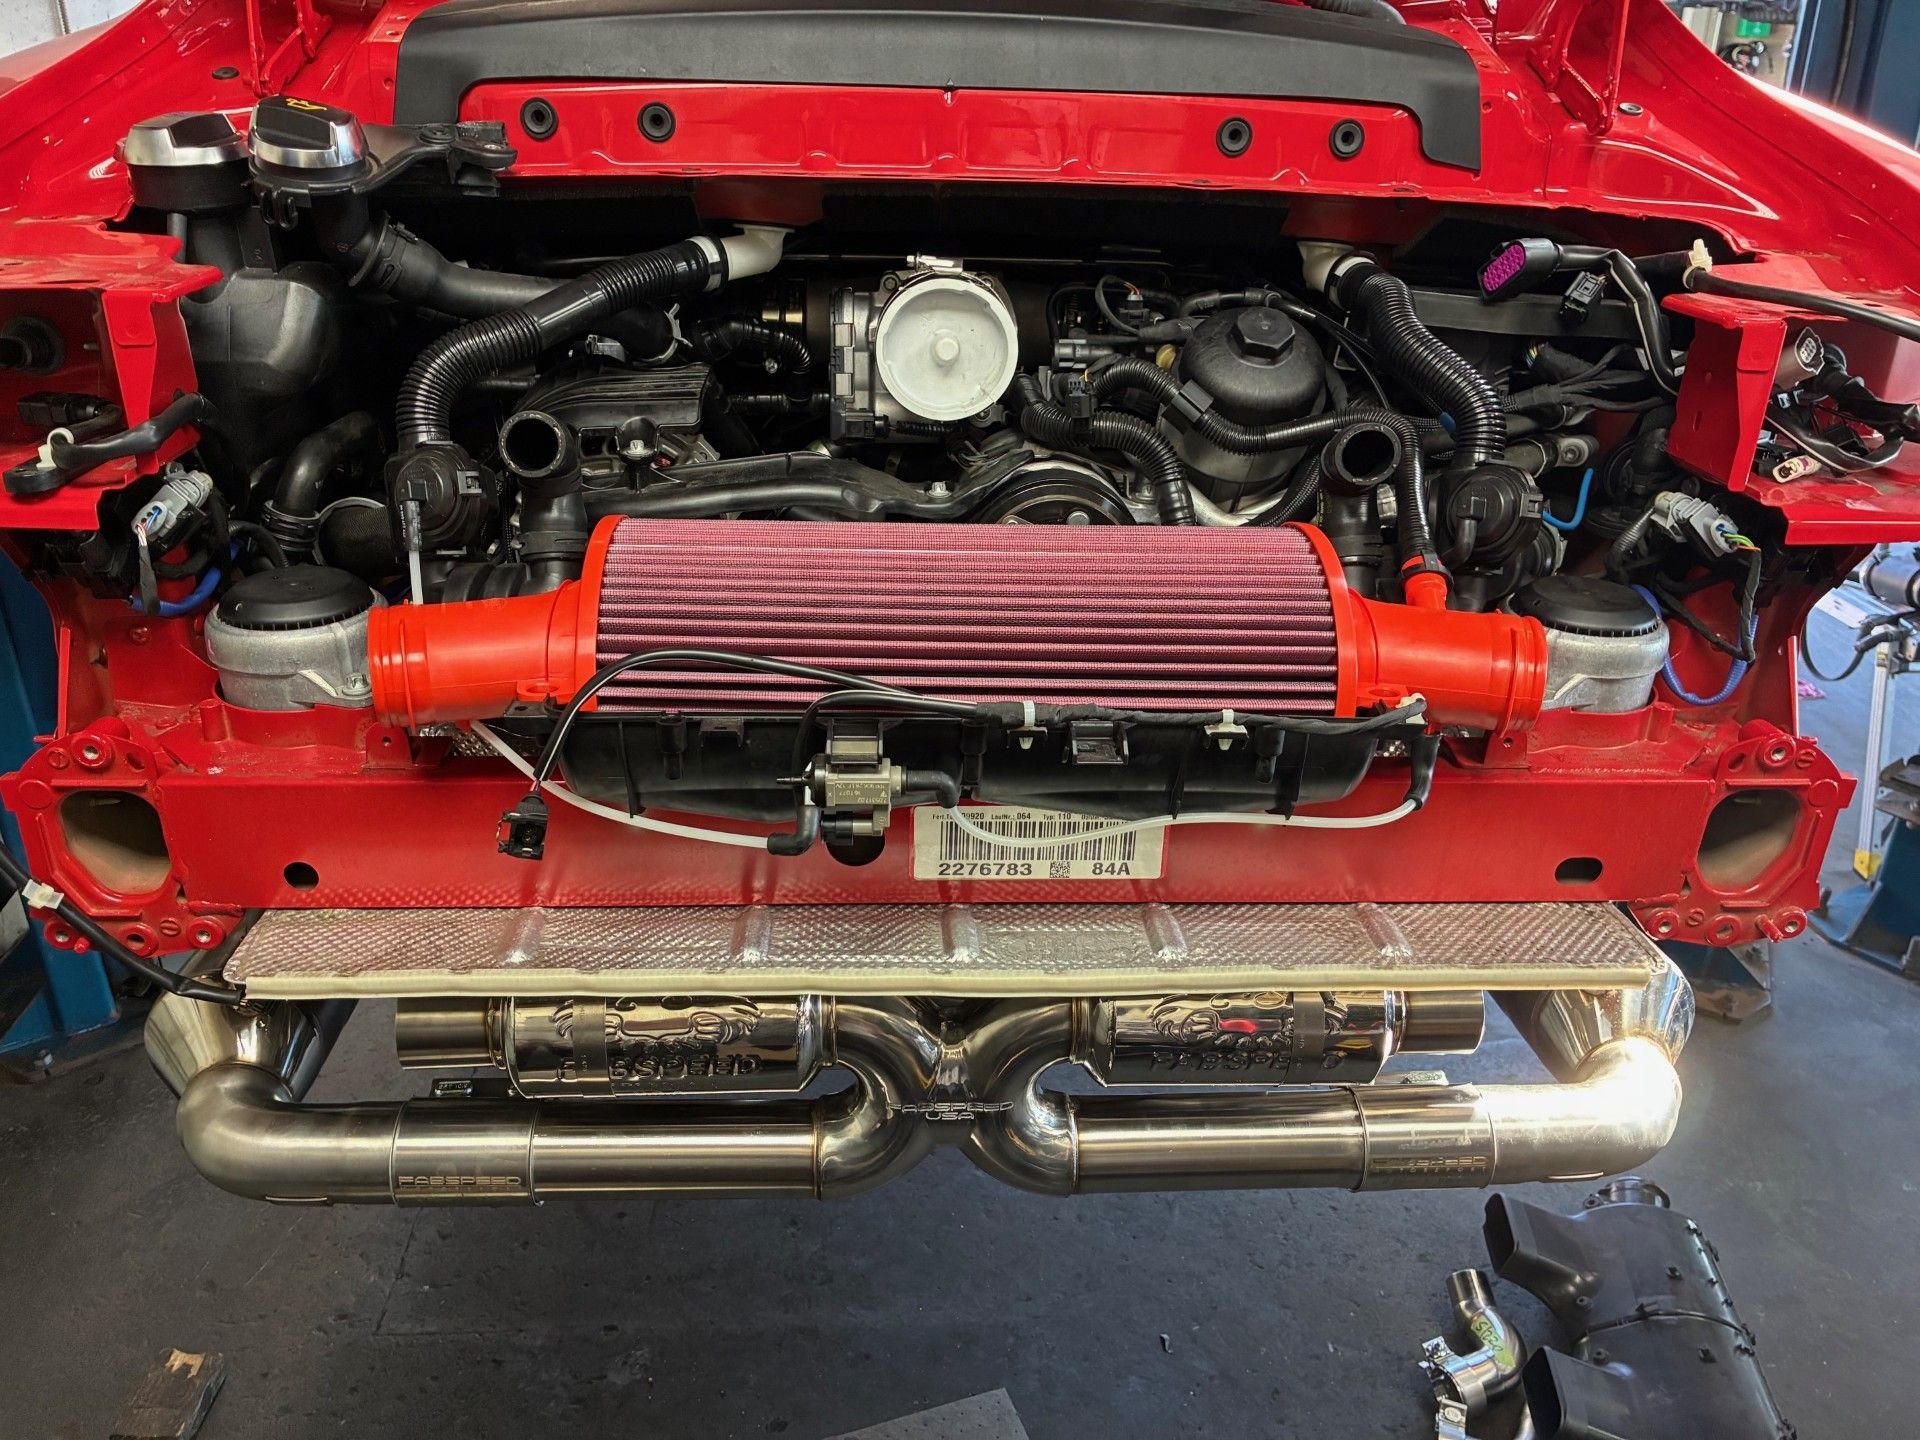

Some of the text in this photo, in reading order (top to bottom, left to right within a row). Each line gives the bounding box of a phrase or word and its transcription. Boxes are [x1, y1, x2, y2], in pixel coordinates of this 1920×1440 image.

[1016, 812, 1031, 820] 064
[1058, 812, 1072, 820] 110
[938, 862, 1131, 876] 2276783 84A
[1150, 1050, 1346, 1071] FABSPED
[556, 1053, 763, 1084] FBSPEED
[925, 1111, 975, 1120] USA
[1372, 1155, 1487, 1167] SPEED
[398, 1175, 521, 1186] FABSPEED
